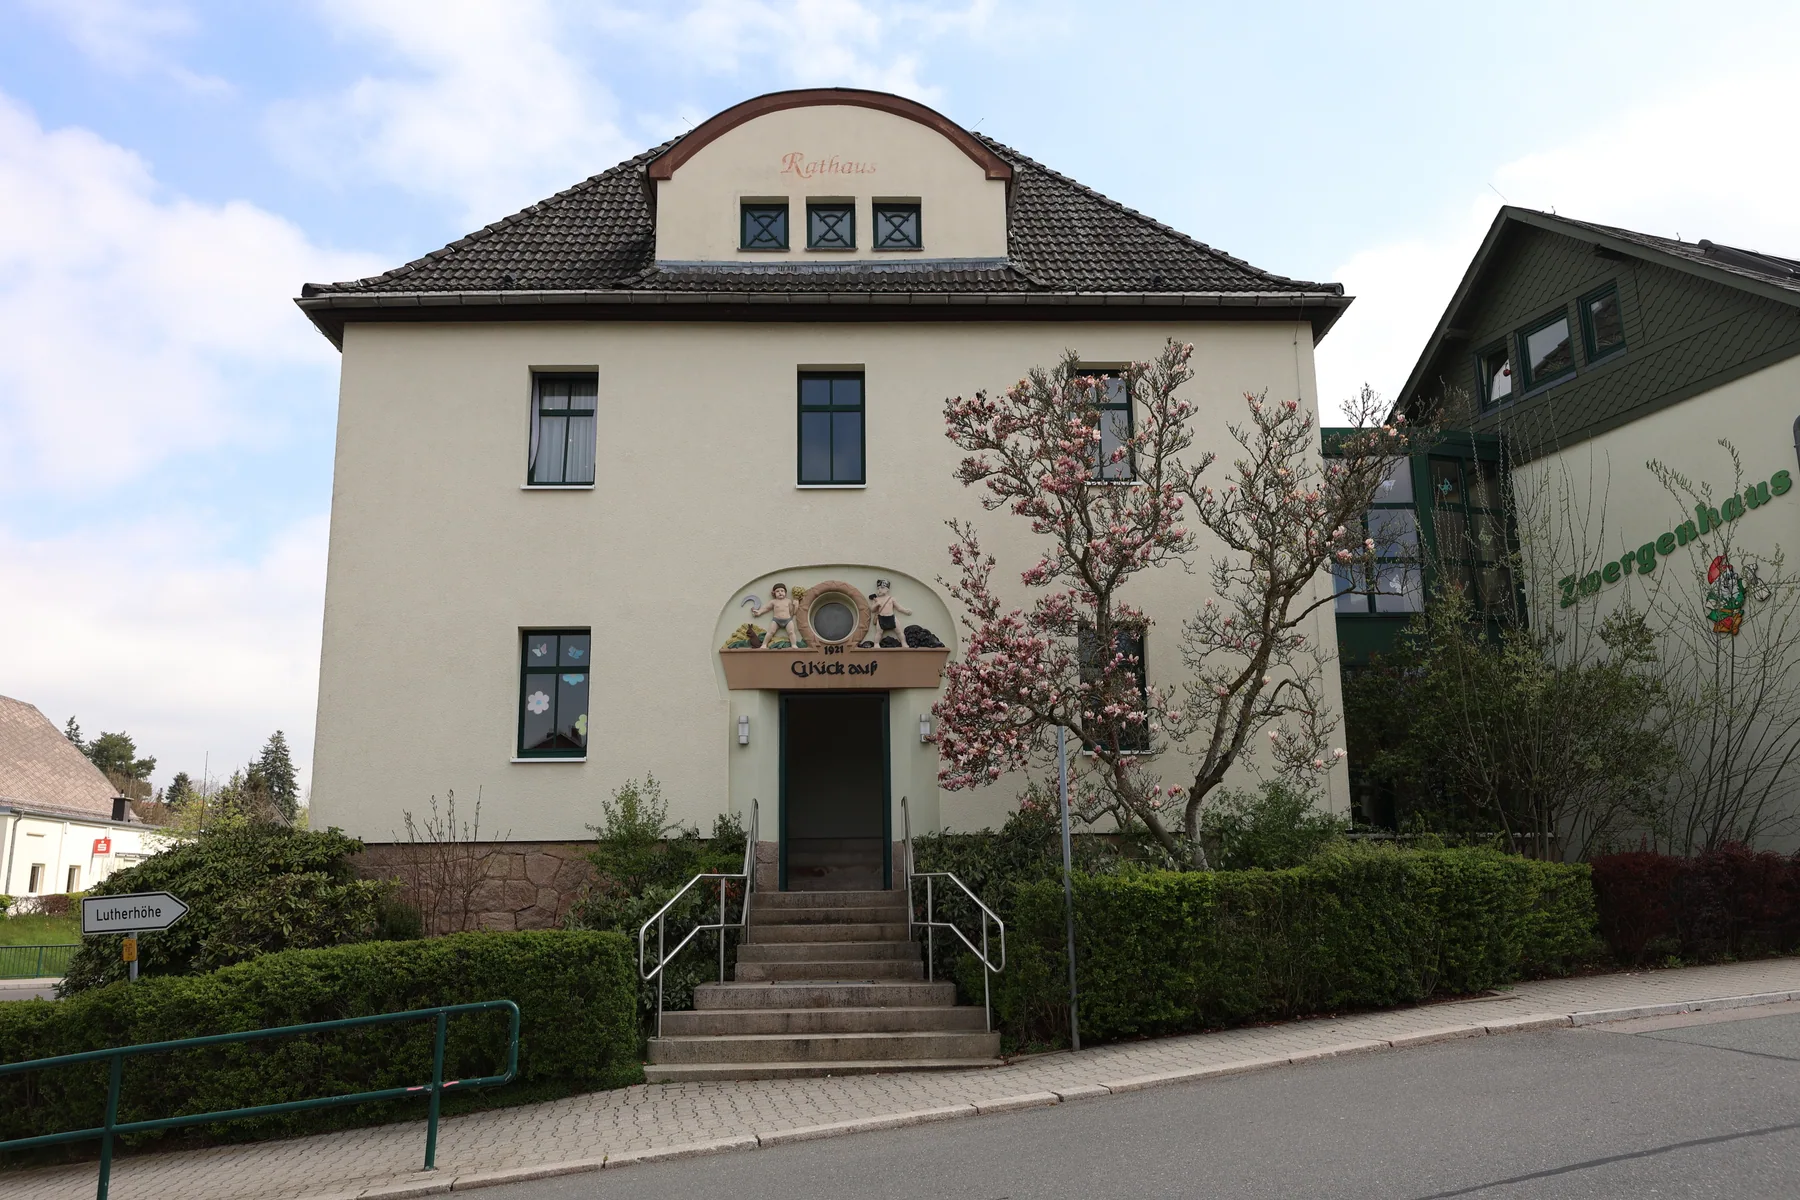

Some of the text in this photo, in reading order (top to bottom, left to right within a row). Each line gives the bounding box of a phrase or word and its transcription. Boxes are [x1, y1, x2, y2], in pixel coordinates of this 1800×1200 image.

[780, 152, 878, 178] Rathaus
[1558, 469, 1793, 609] Zwergenhaus
[824, 645, 844, 655] 1921
[791, 660, 878, 677] Glück auf
[96, 905, 162, 922] Lutherhöhe
